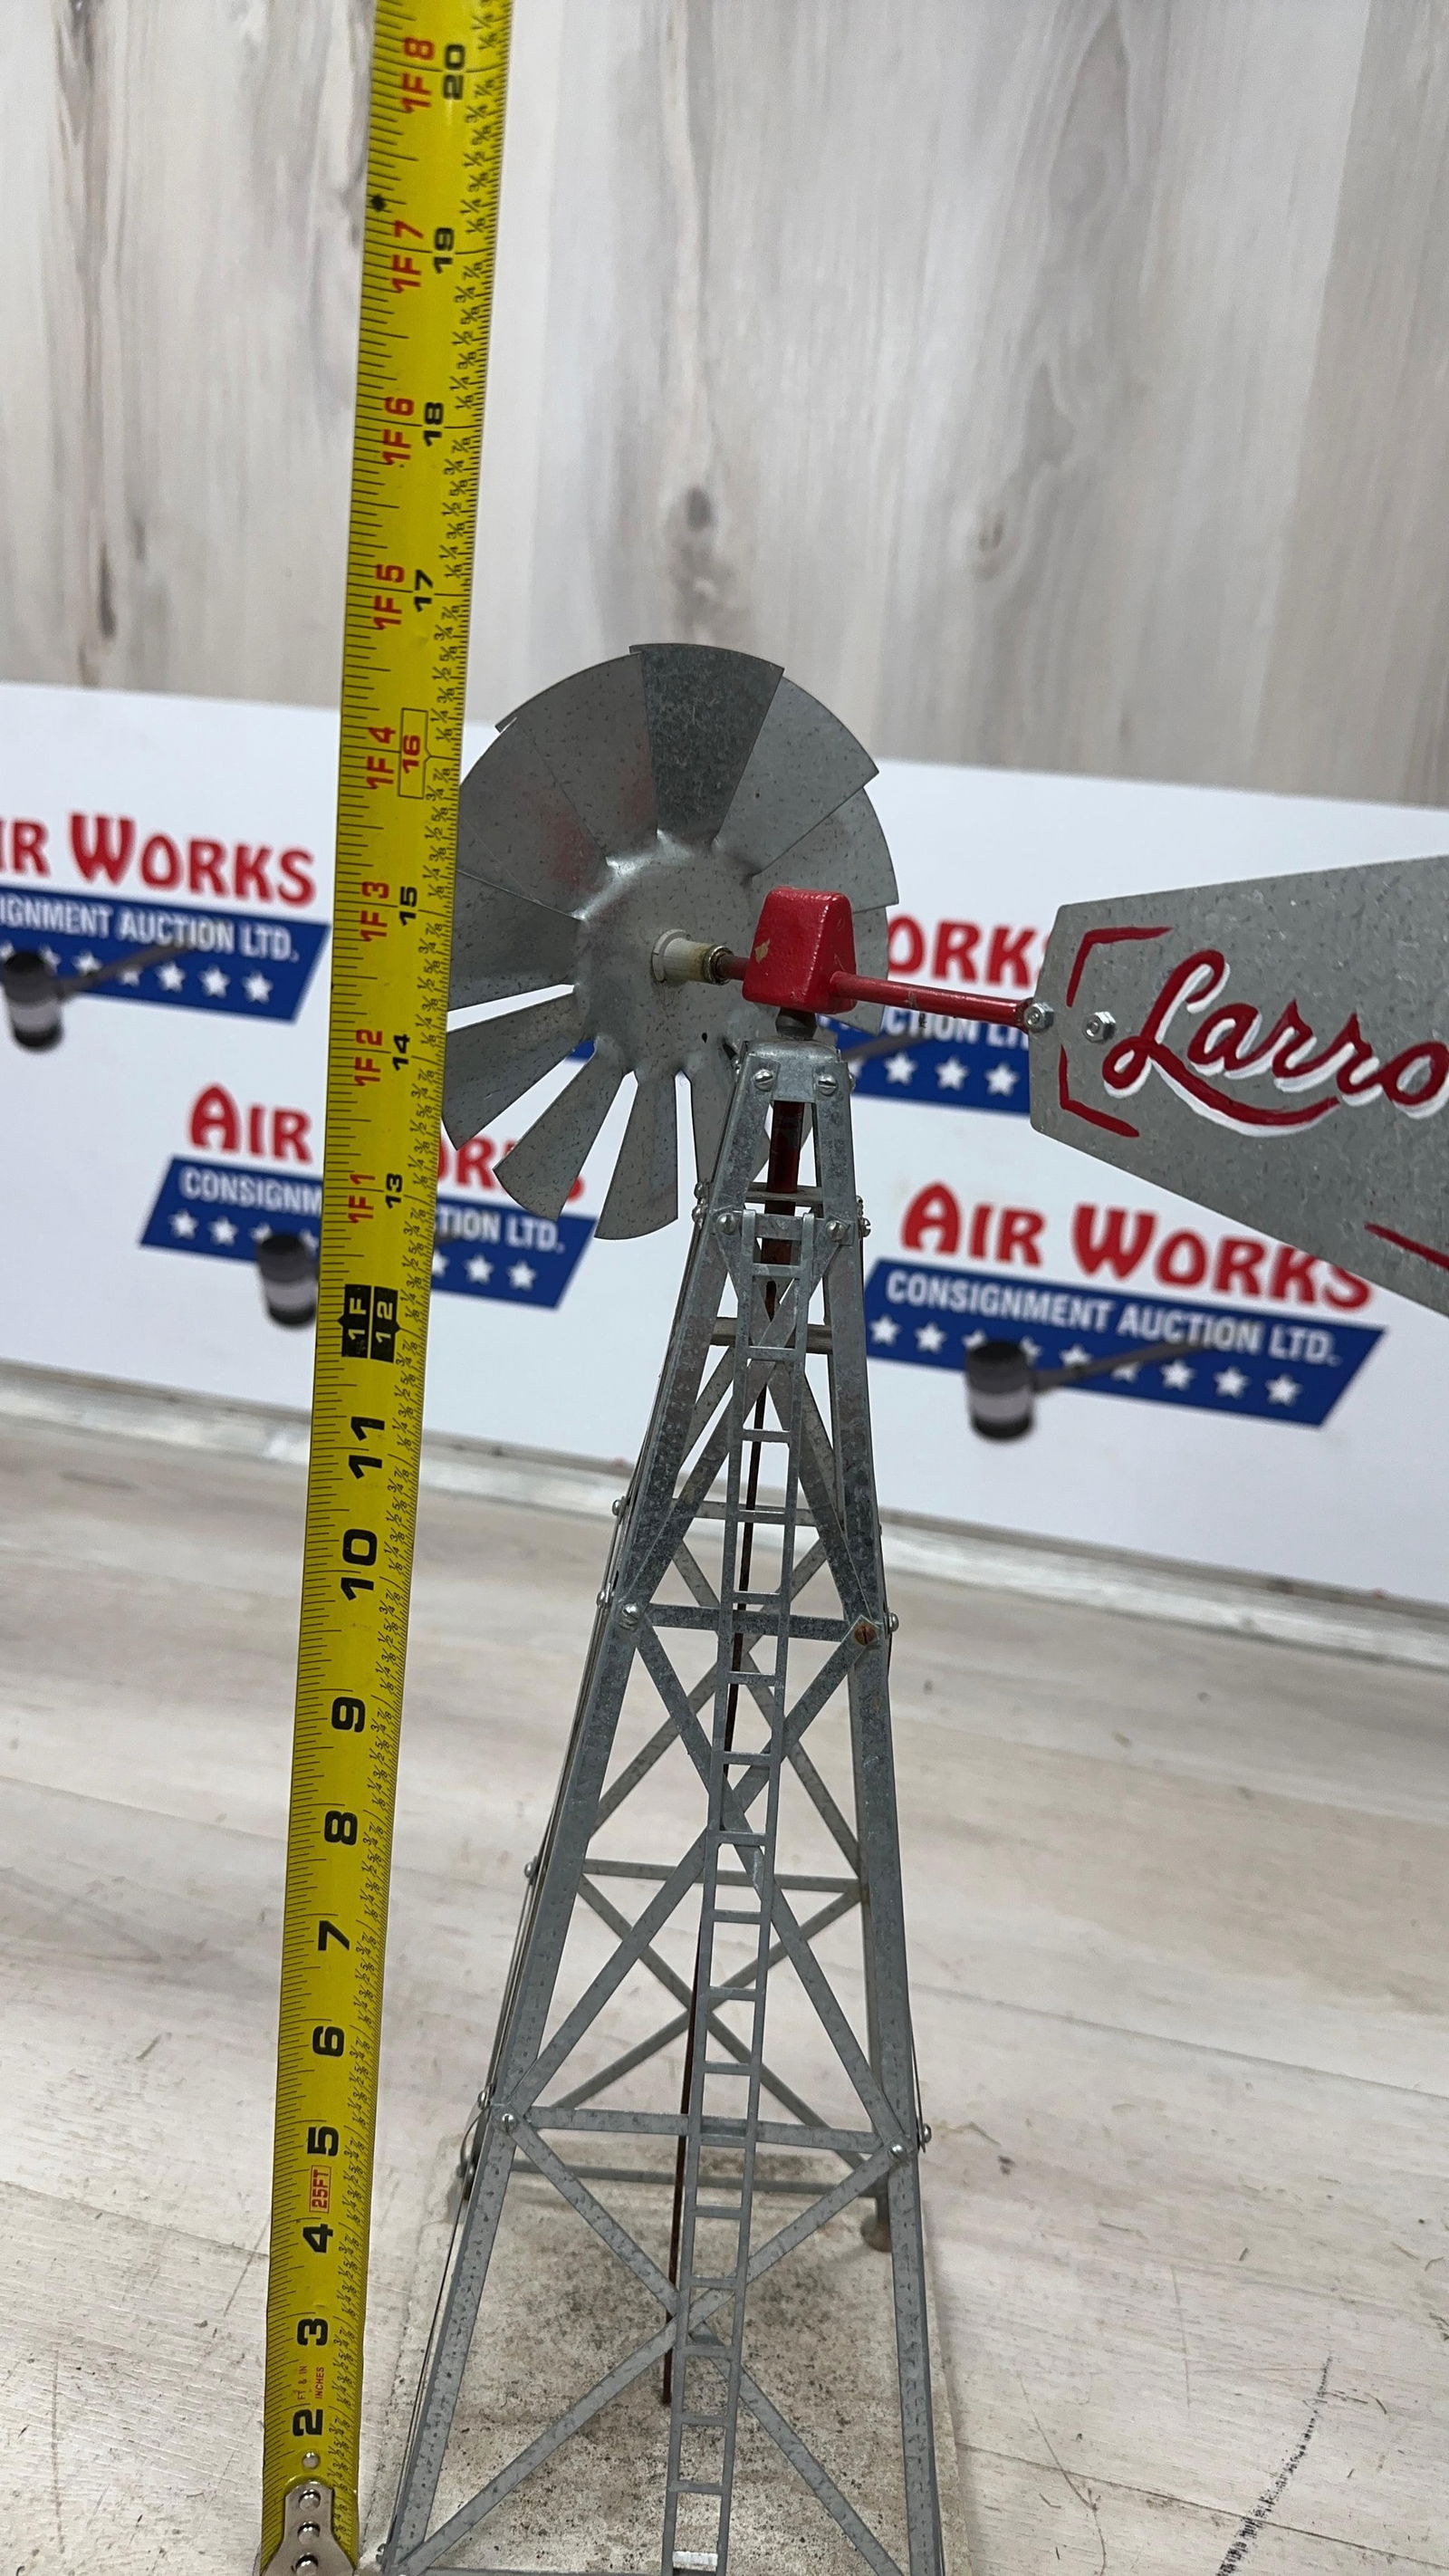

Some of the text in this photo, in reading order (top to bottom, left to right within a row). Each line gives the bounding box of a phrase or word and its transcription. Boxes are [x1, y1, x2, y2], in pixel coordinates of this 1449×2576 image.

[403, 36, 435, 61] 8
[442, 43, 466, 101] 20
[394, 219, 424, 239] 7
[433, 226, 454, 274] 19
[384, 396, 414, 416] 6
[423, 401, 444, 447] 18
[376, 563, 405, 583] 5
[413, 569, 435, 612] 17
[367, 726, 396, 745] 4
[401, 735, 420, 774] 16
[68, 812, 317, 908] WORKS
[361, 881, 389, 899] 3
[399, 886, 417, 926] 15
[117, 908, 235, 954] AUCTION
[239, 925, 301, 964] LTD.
[888, 915, 1051, 990] ORK
[355, 1029, 383, 1046] 2
[391, 1033, 411, 1071] 14
[1102, 948, 1449, 1137] Larro
[189, 1082, 313, 1166] AIR
[350, 1172, 376, 1184] 1
[385, 1173, 403, 1208] 13
[179, 1166, 566, 1254] CONSIGNM TION LTD.
[899, 1180, 1374, 1313] AIR WORKS
[348, 1297, 367, 1341] 1F
[375, 1301, 393, 1343] 12
[886, 1268, 1342, 1367] CONSIGNMENT AUCTION LTD.
[349, 1416, 385, 1479] 11
[341, 1528, 378, 1600] 10
[331, 1697, 366, 1734] 9
[323, 1811, 358, 1846] 8
[317, 1920, 350, 1951] 7
[312, 2025, 345, 2057] 6
[307, 2126, 340, 2157] 5
[312, 2168, 330, 2209] 25FT
[302, 2224, 333, 2254] 4
[296, 2318, 329, 2346] 3
[314, 2366, 324, 2399] INCHES
[293, 2408, 323, 2437] 2
